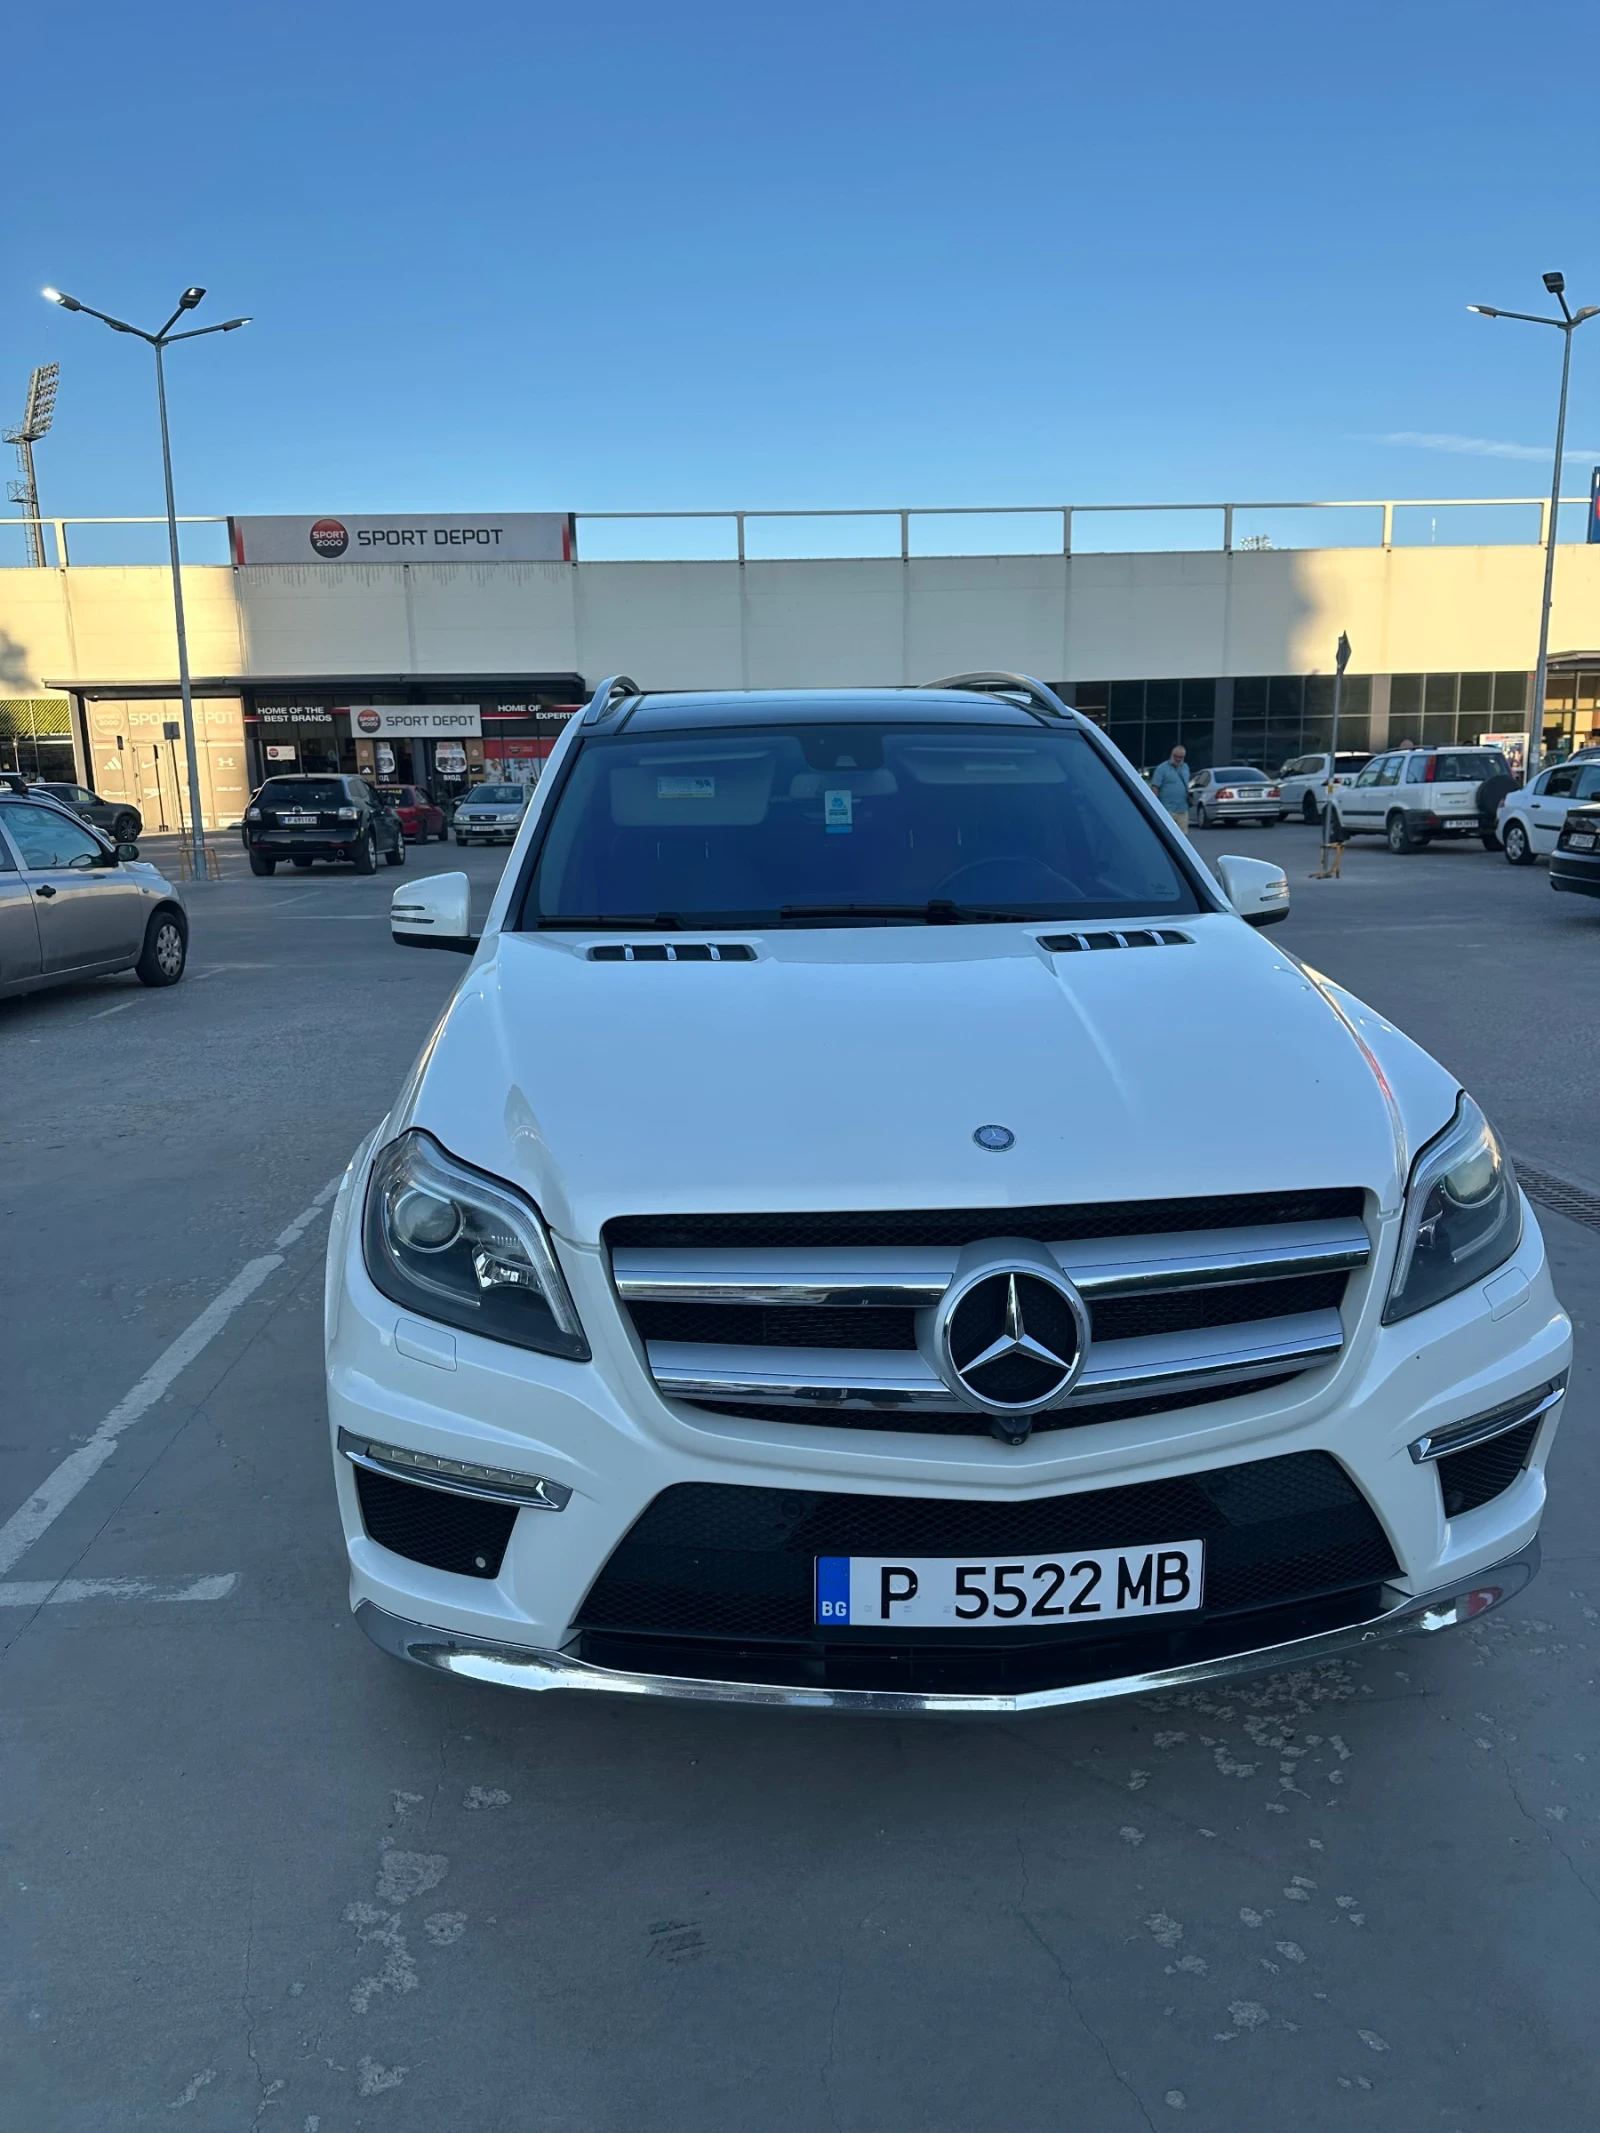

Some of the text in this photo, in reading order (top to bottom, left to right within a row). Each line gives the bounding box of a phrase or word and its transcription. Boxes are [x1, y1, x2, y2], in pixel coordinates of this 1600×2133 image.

[312, 530, 345, 539] SPORT
[357, 529, 503, 546] SPORT DEPOT
[316, 539, 343, 547] 2000
[258, 707, 287, 715] HOME
[305, 706, 325, 714] THE
[498, 704, 541, 712] HOME OF
[129, 711, 236, 725] SPORT EPOT
[292, 714, 332, 722] BRANDS
[385, 715, 474, 726] SPORT DEPOT
[880, 1550, 1190, 1619] P 5522 MB
[822, 1601, 847, 1617] BG
